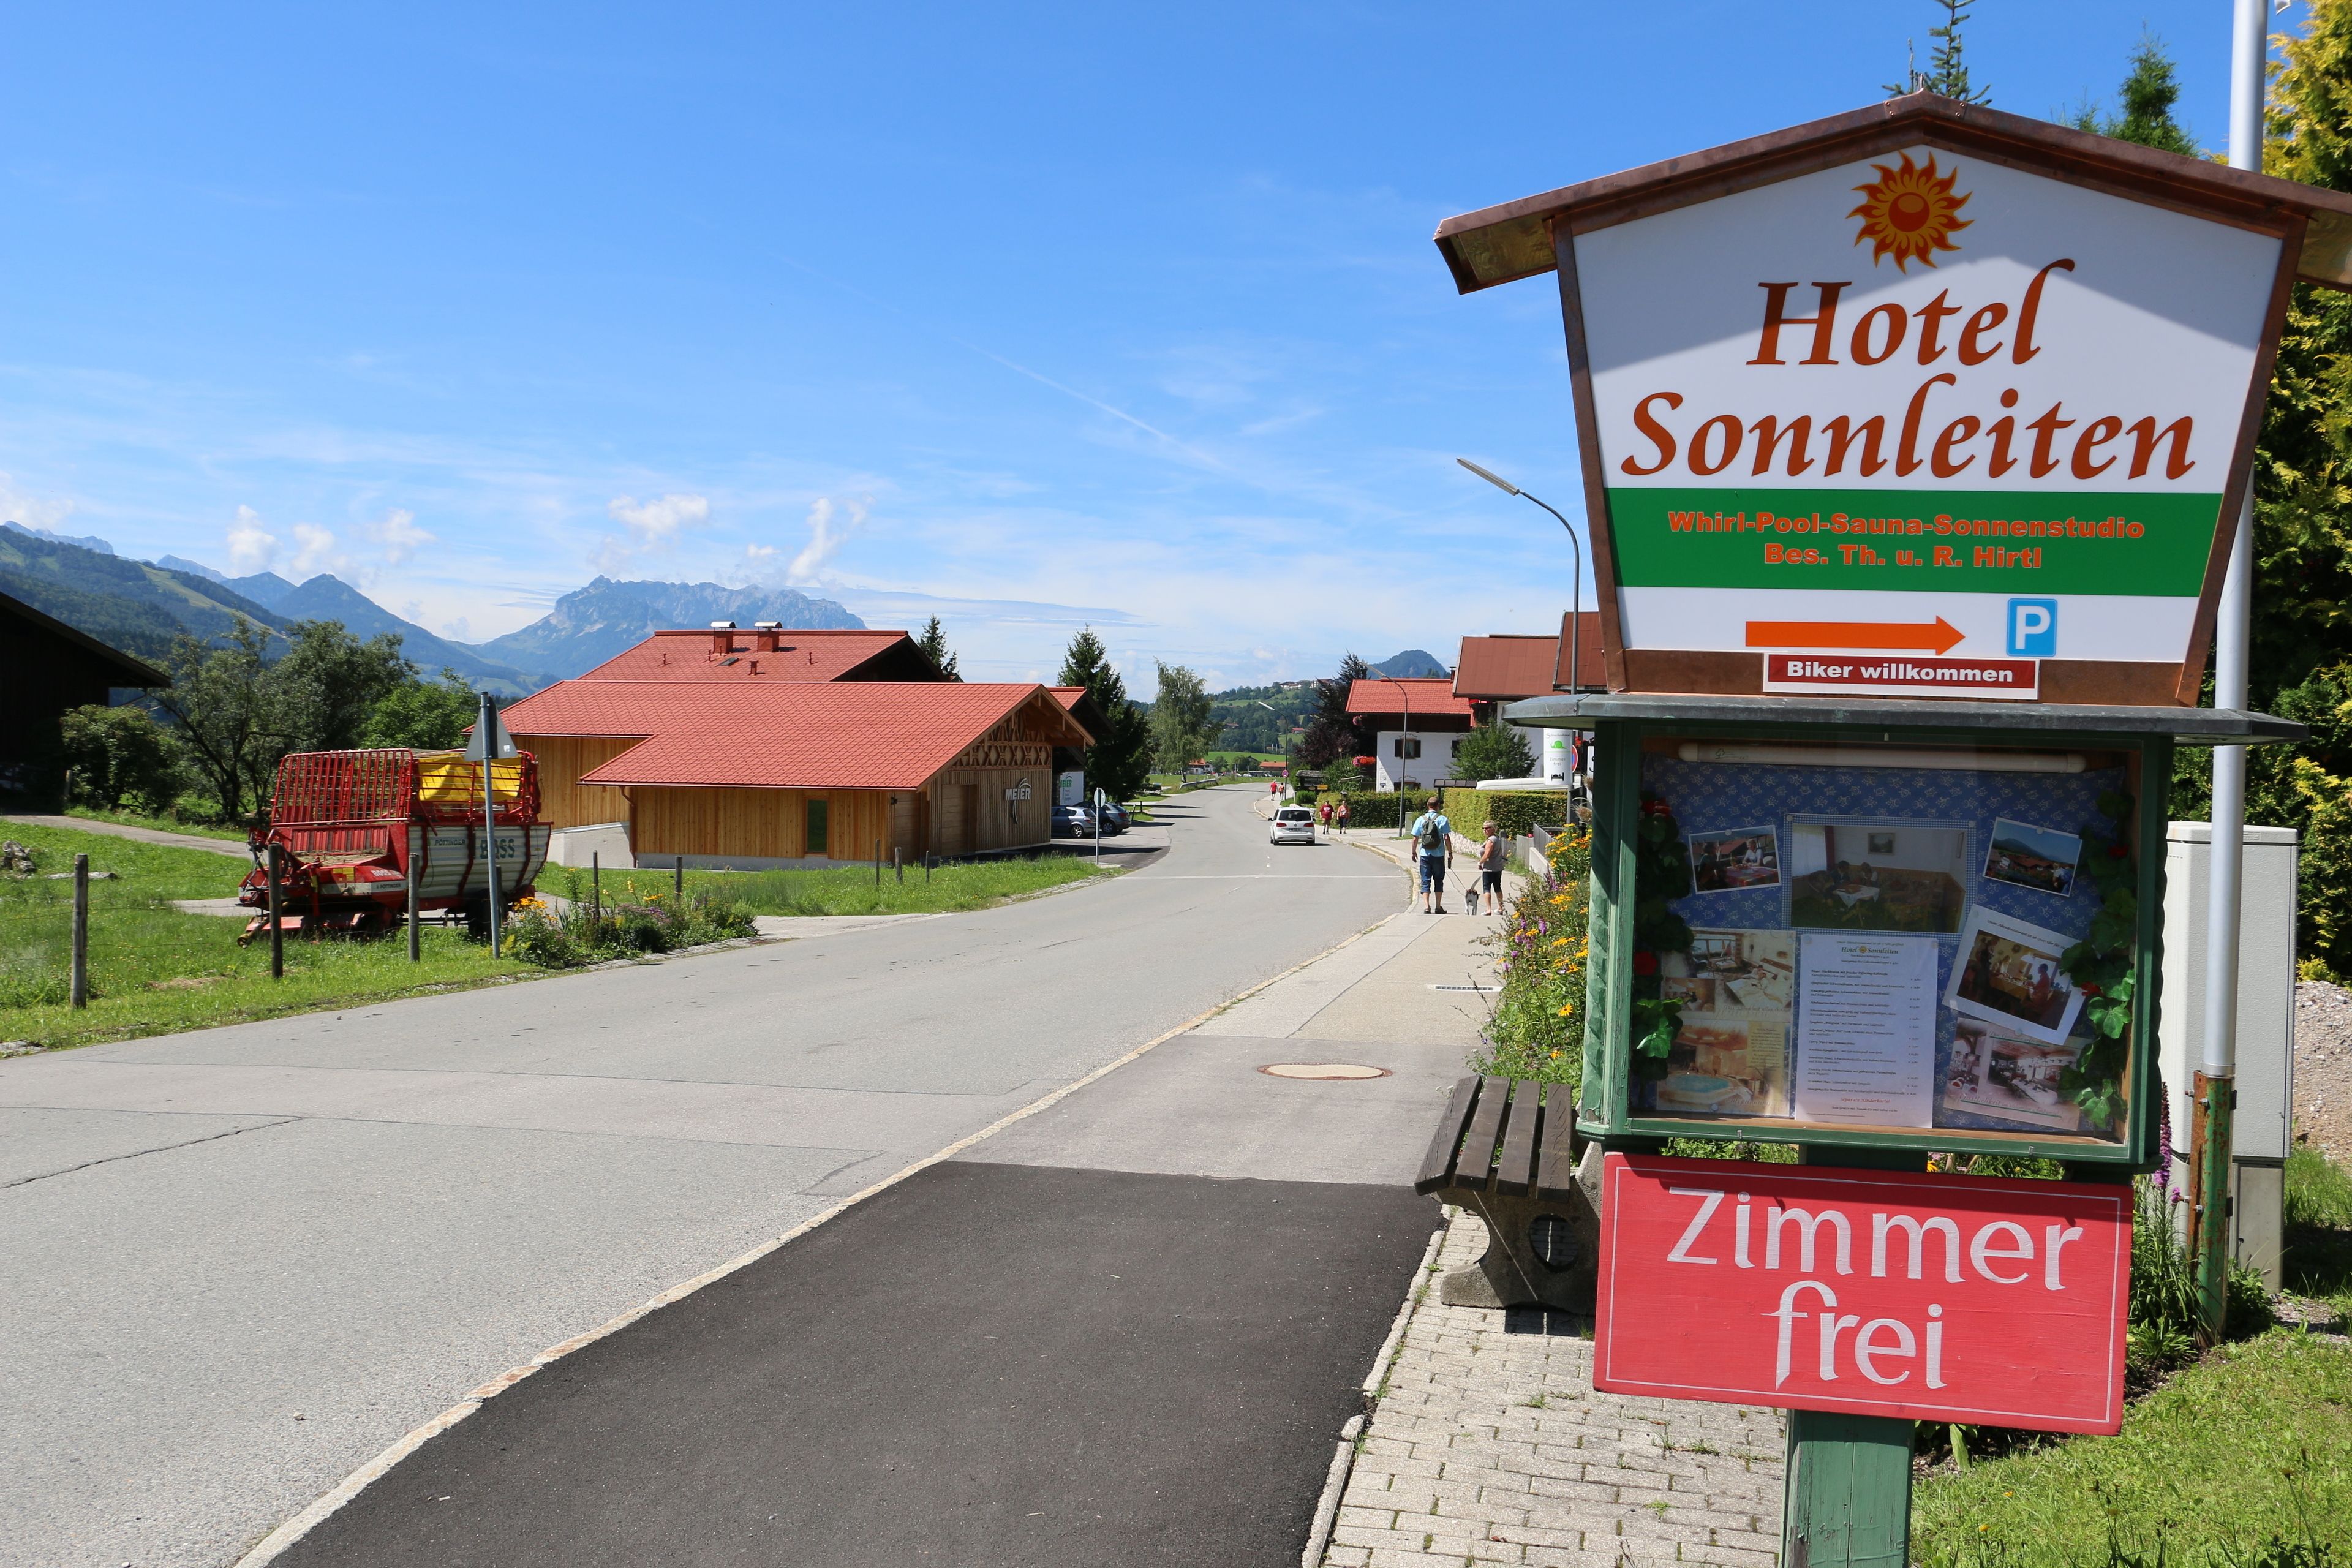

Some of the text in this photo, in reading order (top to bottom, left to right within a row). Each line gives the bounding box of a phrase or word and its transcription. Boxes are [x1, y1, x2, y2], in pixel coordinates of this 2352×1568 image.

[1746, 260, 2075, 366] Hotel
[1621, 372, 2195, 480] Sonnleiten
[1668, 511, 2145, 539] Whirl-Pool-Sauna-Sonnenstudio
[1764, 543, 2042, 568] Bes. Th. u. R. Hirtl
[2015, 605, 2051, 650] P
[1786, 660, 2014, 683] Biker willkommen
[1005, 788, 1030, 801] MEIER
[1666, 1186, 2084, 1292] Zimmer
[1760, 1280, 1947, 1390] frei
